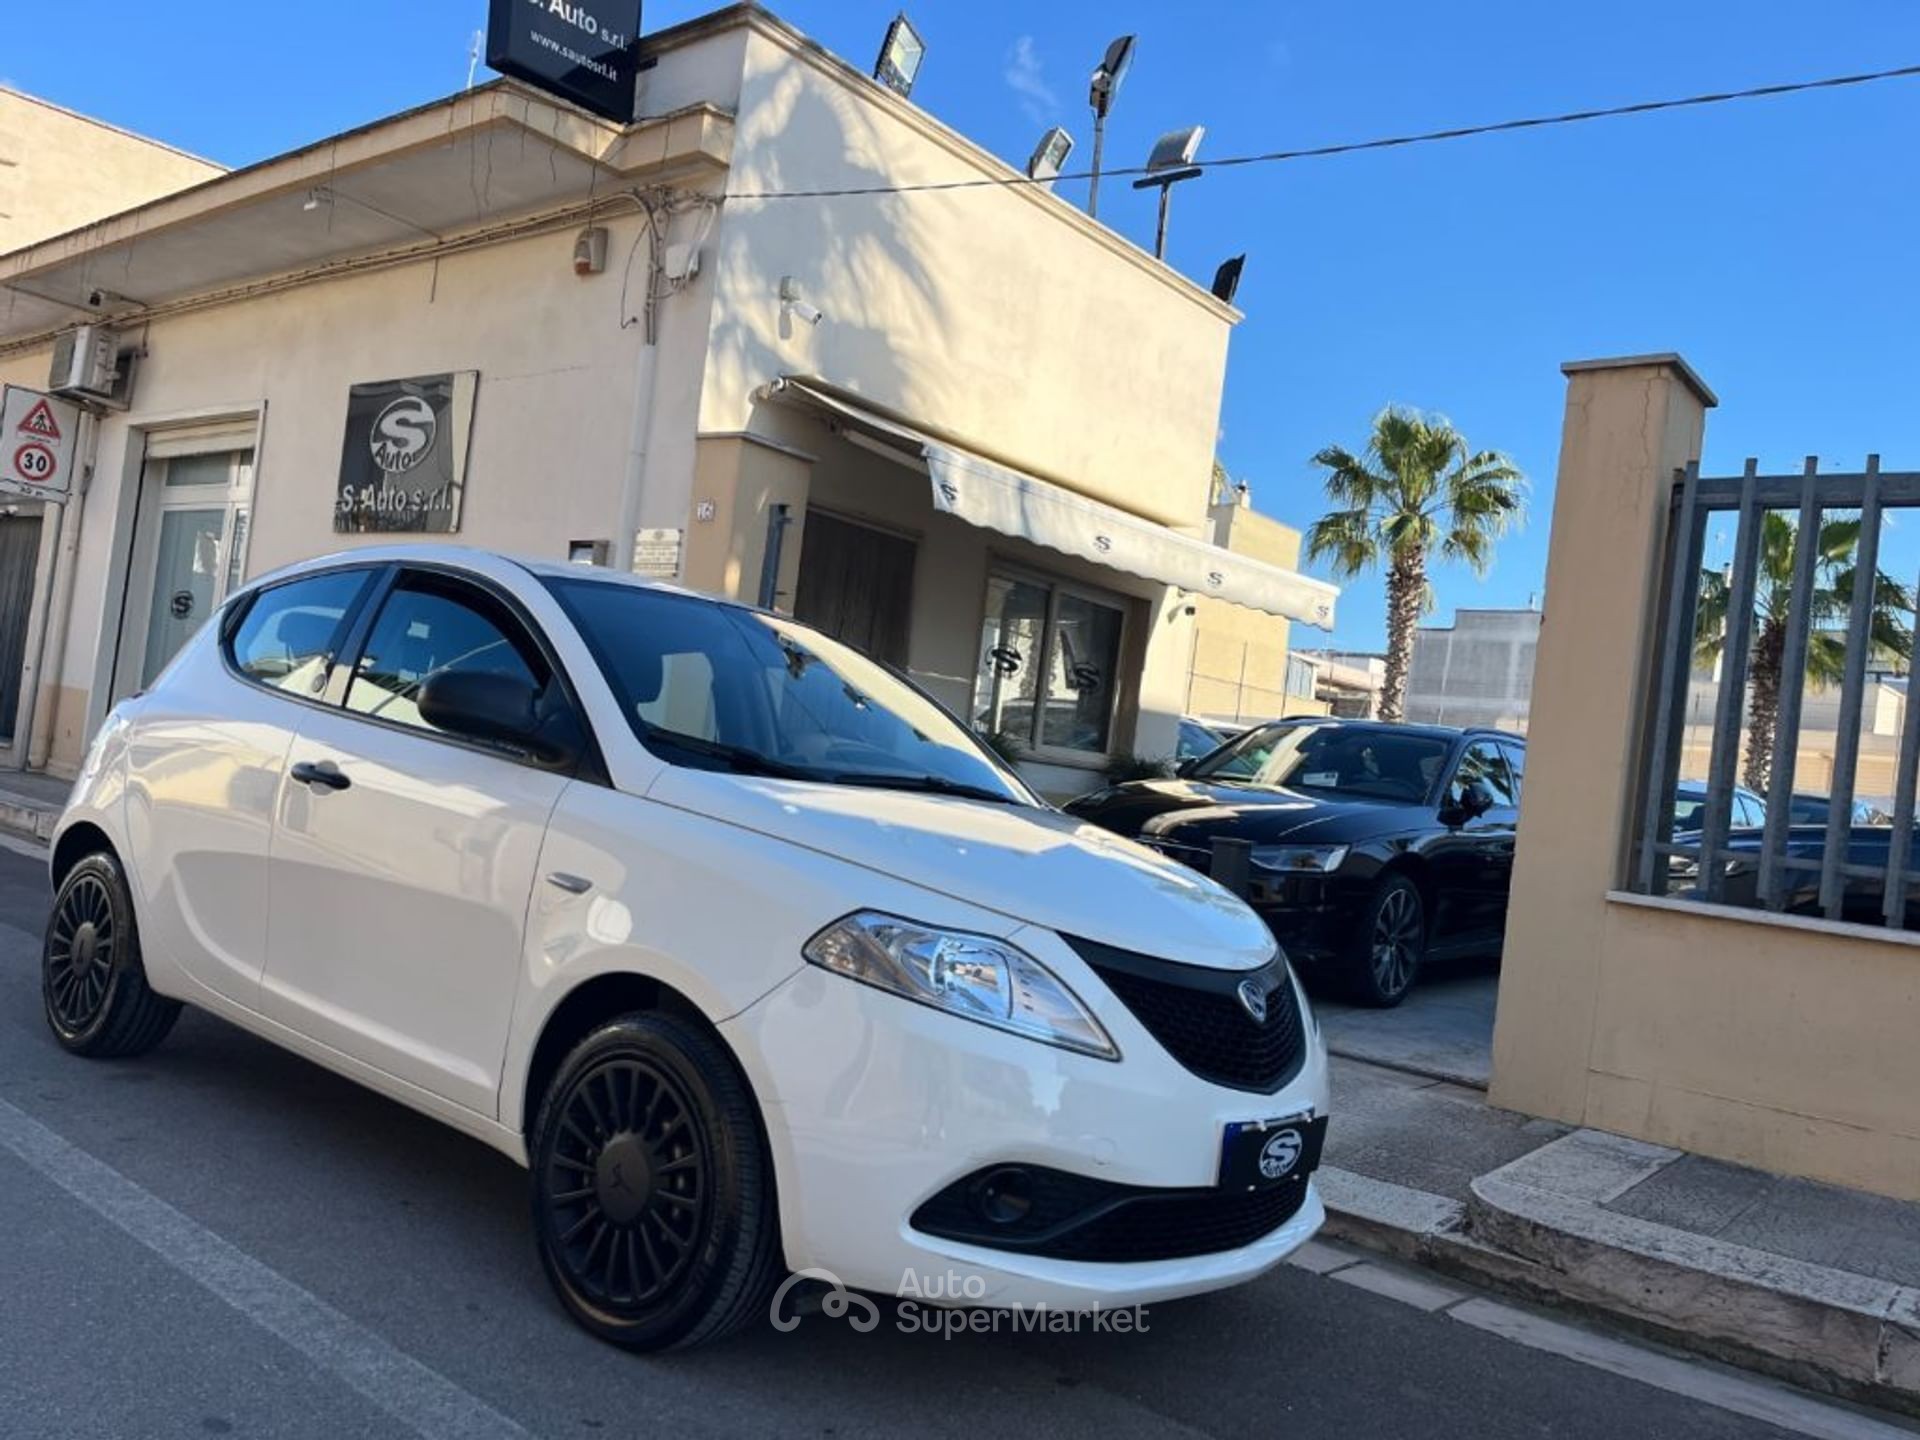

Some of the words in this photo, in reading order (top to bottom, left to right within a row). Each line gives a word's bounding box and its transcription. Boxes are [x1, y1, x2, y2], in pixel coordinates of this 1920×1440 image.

[549, 0, 598, 35] Auto
[530, 30, 617, 82] www.sautosrl.it
[23, 452, 48, 472] 30
[374, 441, 418, 471] Auto
[360, 484, 407, 512] Auto
[173, 594, 192, 614] S
[1267, 1133, 1301, 1163] S
